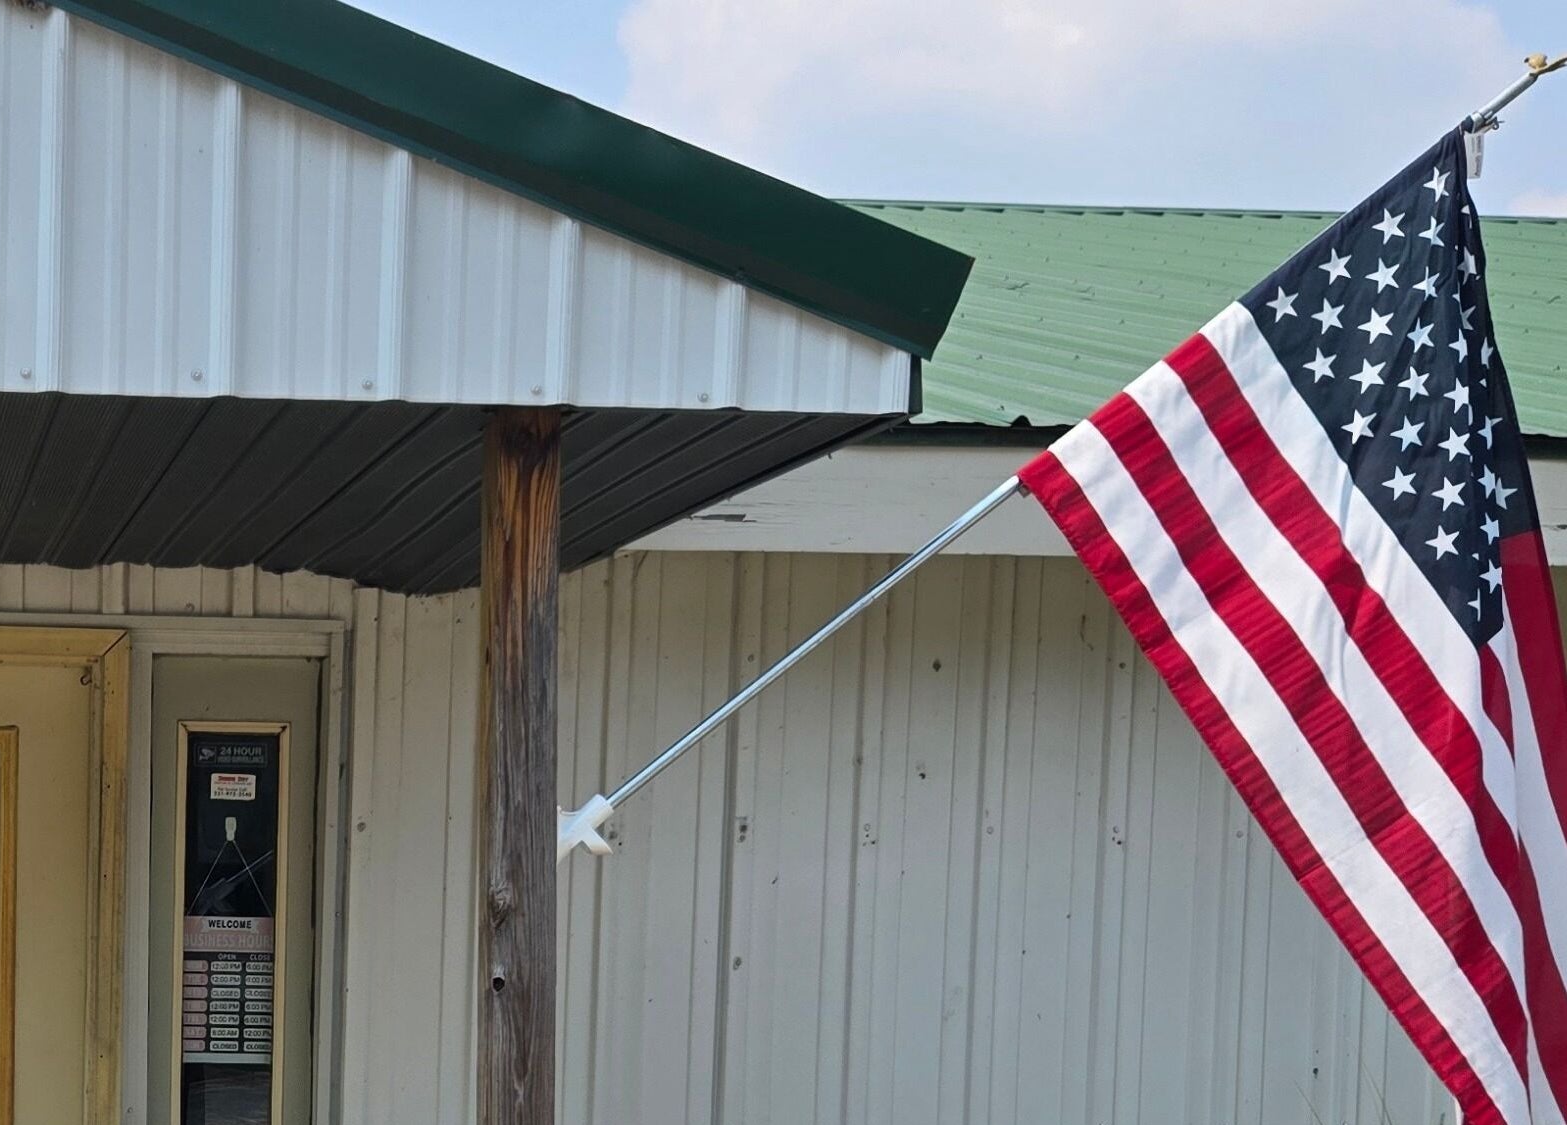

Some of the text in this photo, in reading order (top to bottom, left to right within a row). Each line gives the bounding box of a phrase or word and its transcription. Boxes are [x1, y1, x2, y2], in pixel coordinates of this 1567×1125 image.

[220, 746, 262, 756] 24 HOUR
[208, 919, 252, 929] WELCOME
[238, 934, 273, 949] HOUR
